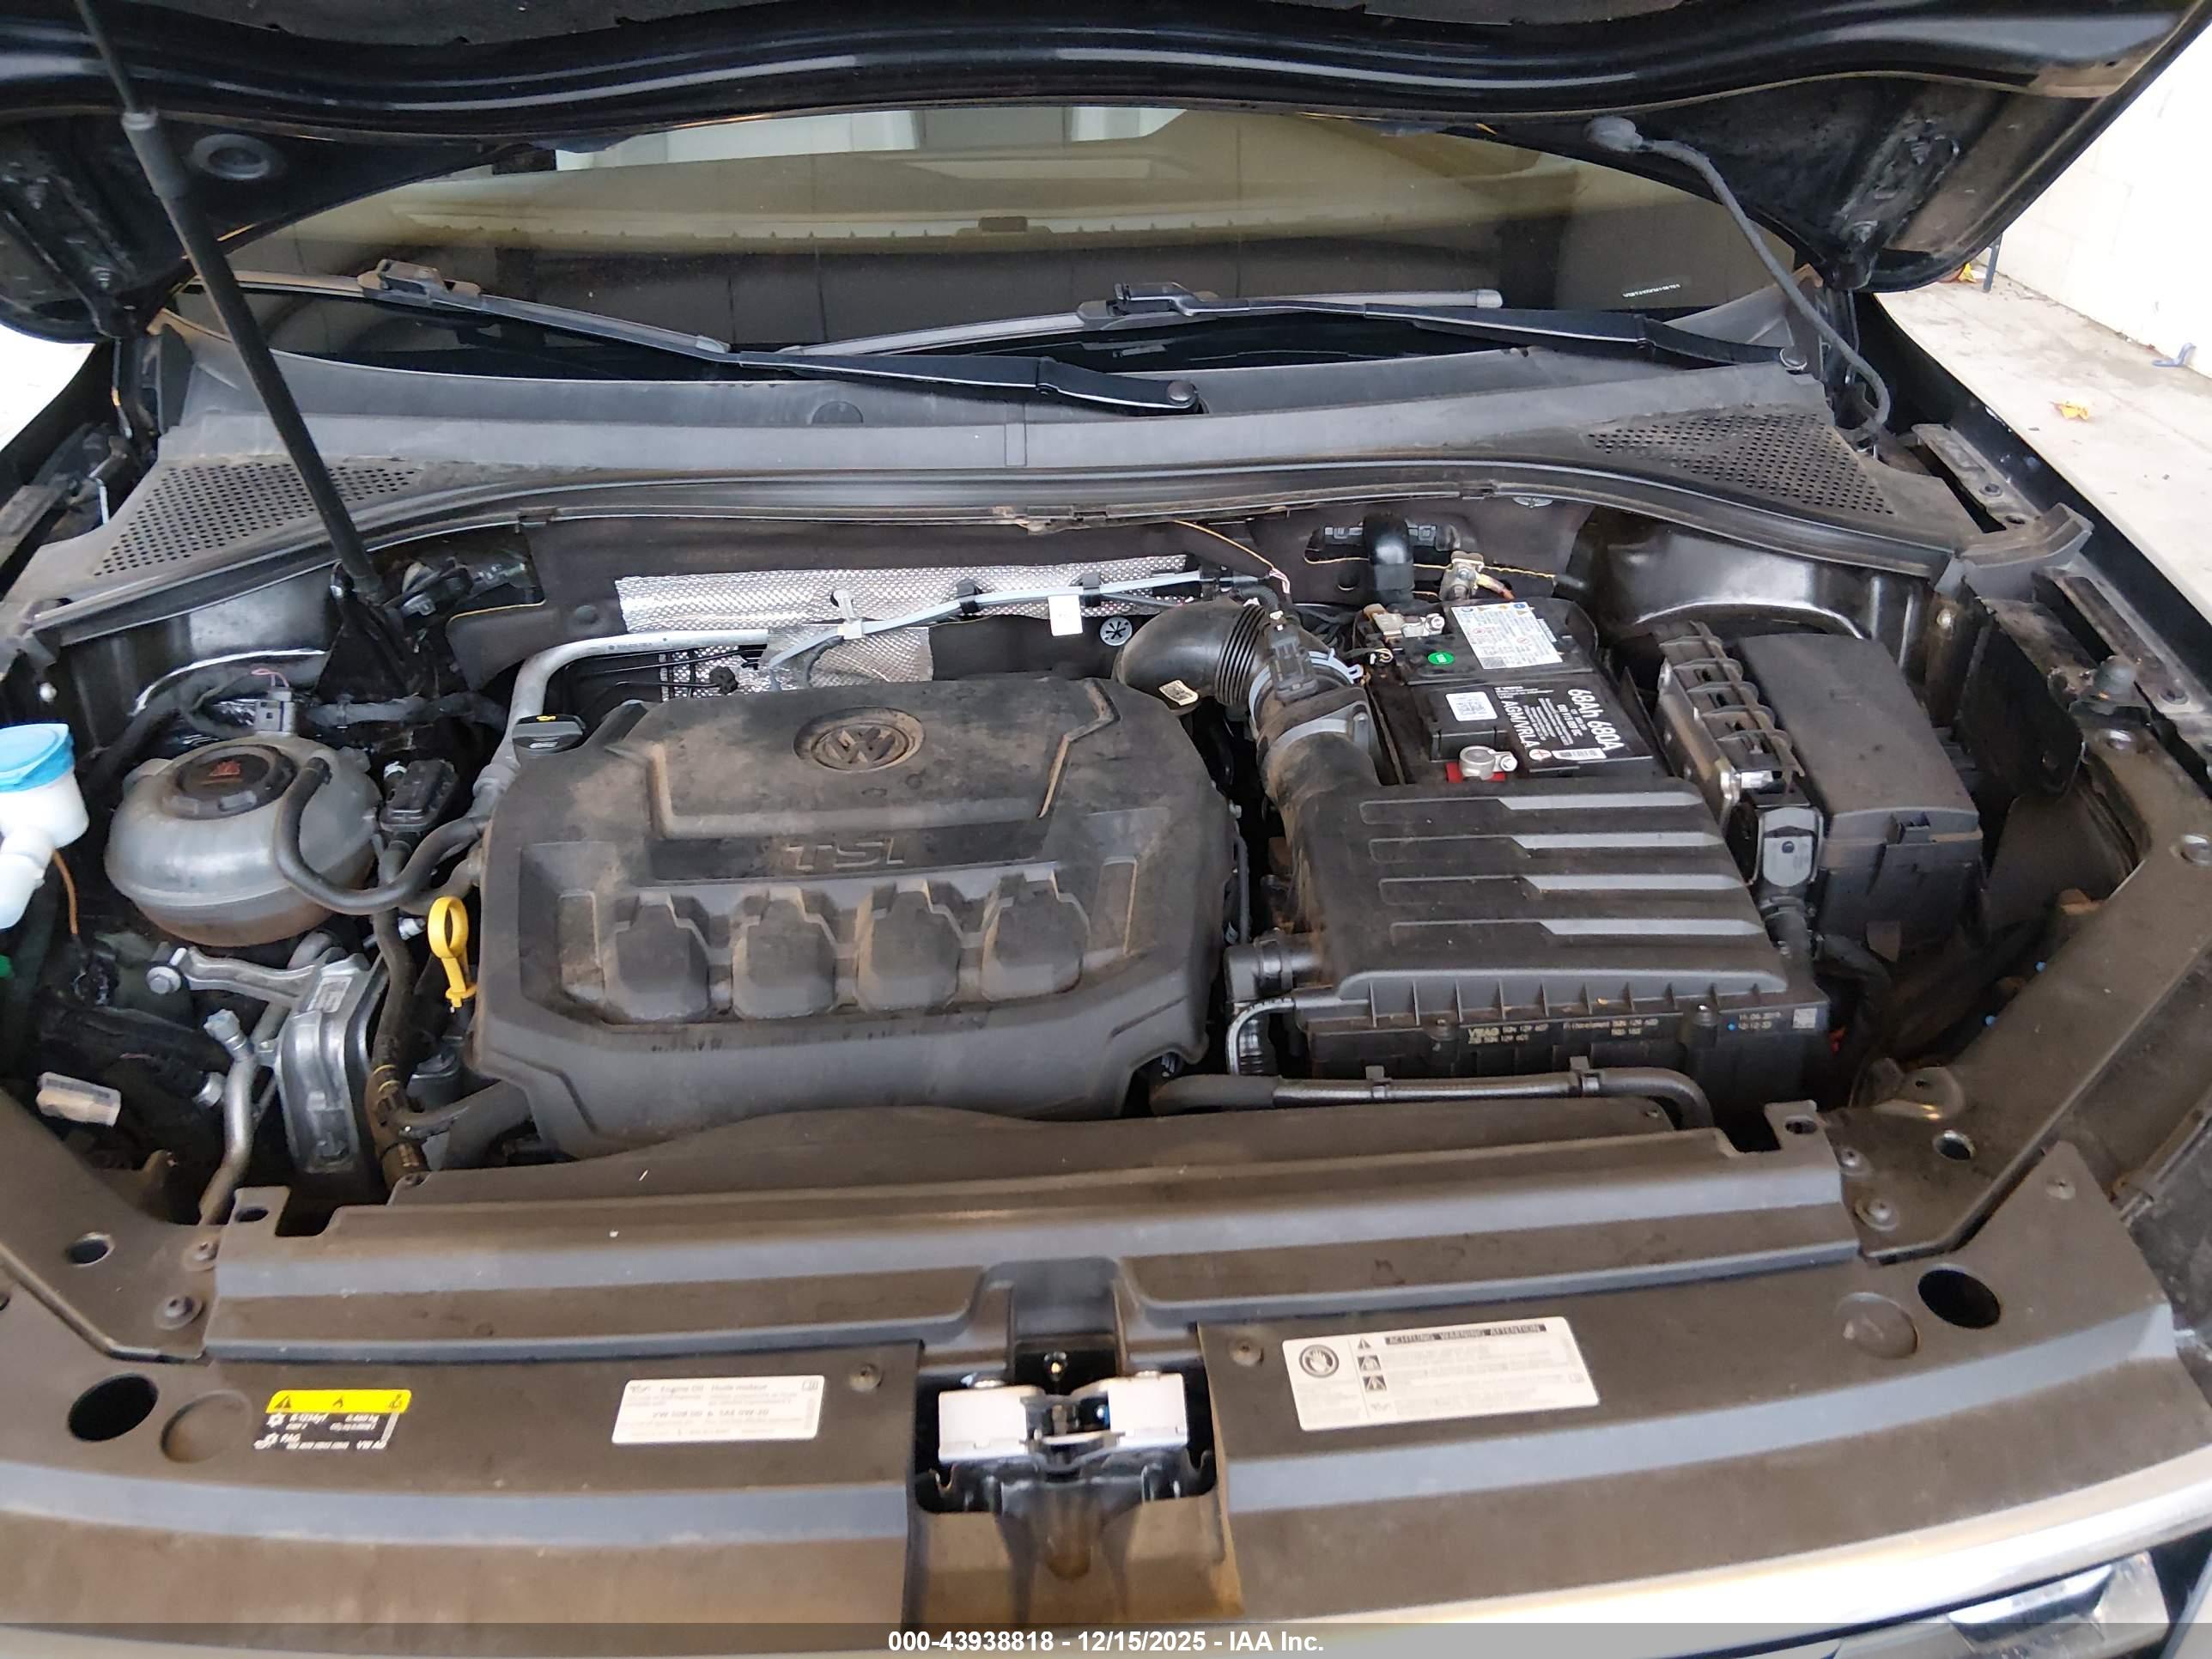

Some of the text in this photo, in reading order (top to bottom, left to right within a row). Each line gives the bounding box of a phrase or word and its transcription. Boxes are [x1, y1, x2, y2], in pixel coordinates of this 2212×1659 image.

[1500, 700, 1540, 749] AGM/VRLA
[1567, 689, 1604, 718] 68Ah
[1586, 720, 1625, 751] 680A
[784, 836, 905, 872] TSI
